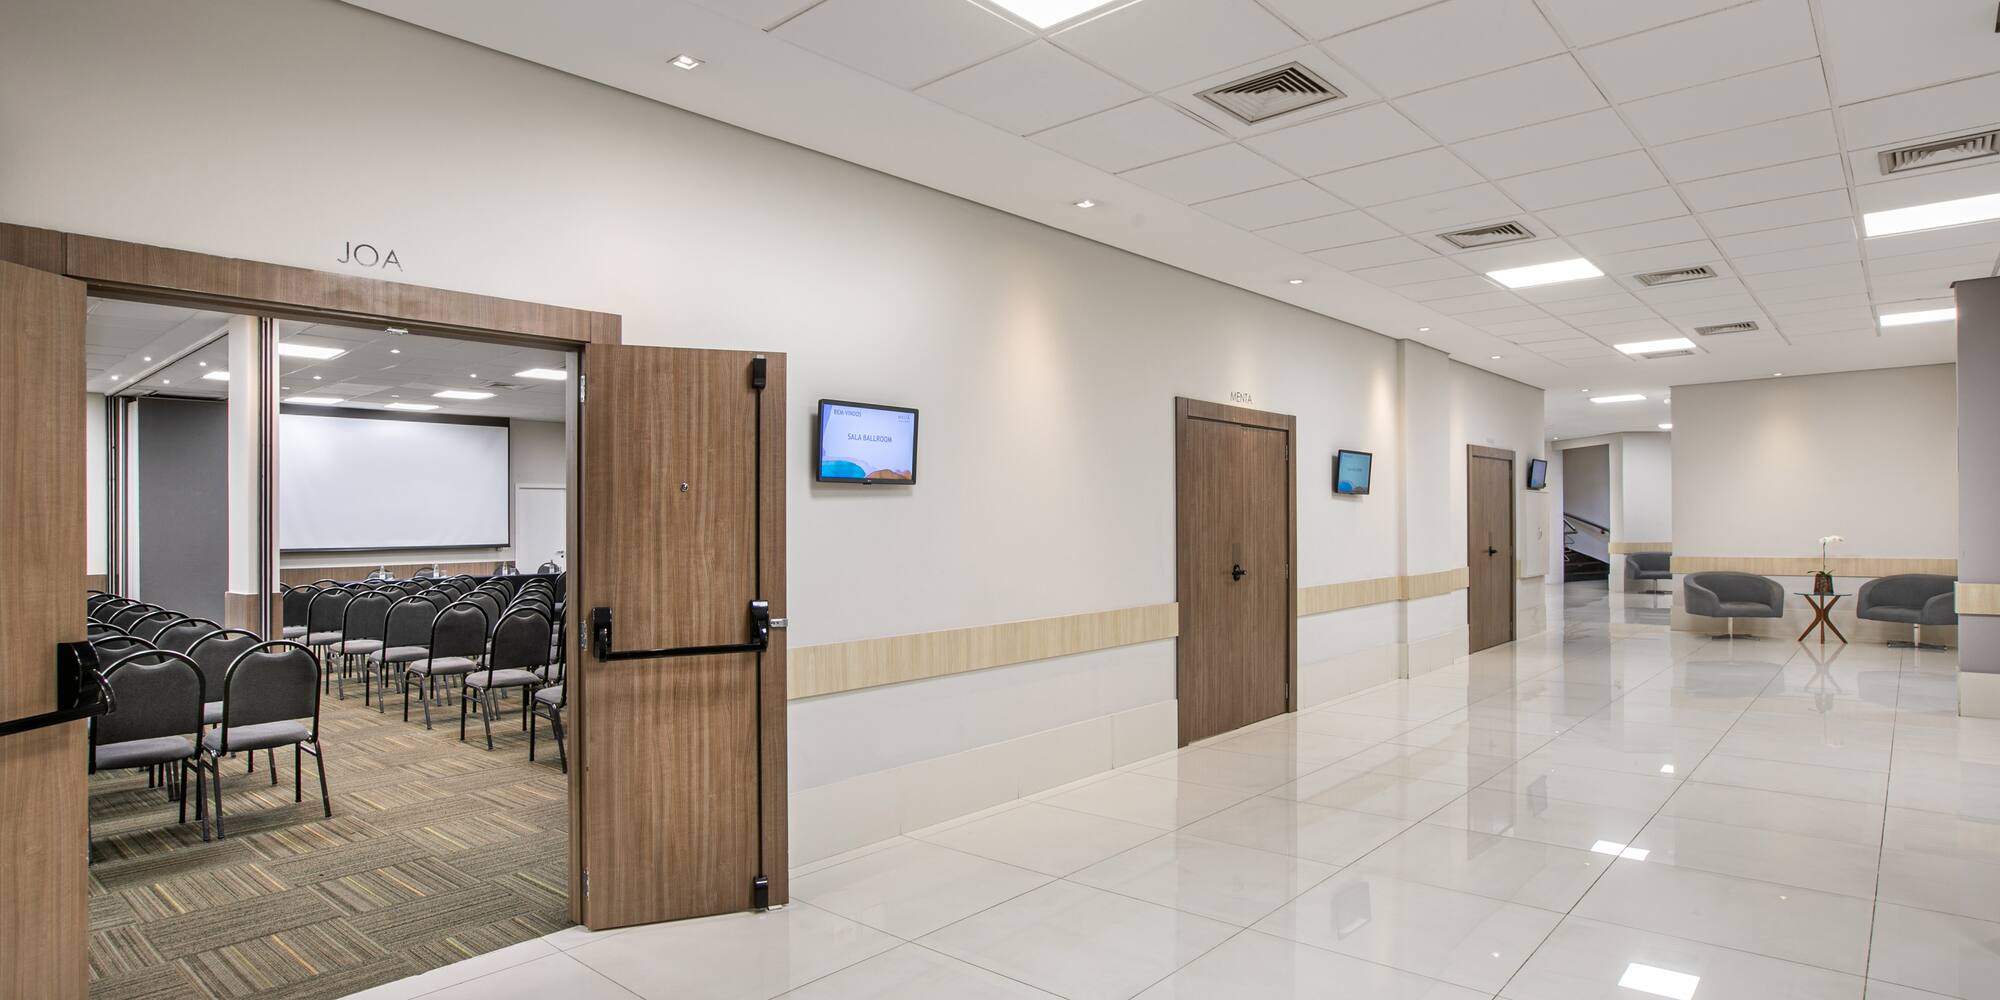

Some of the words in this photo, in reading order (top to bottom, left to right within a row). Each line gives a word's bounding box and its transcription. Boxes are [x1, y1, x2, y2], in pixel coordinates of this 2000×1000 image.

[337, 241, 403, 272] JOA
[1230, 391, 1253, 405] MENTA
[863, 434, 892, 443] BALLROOM
